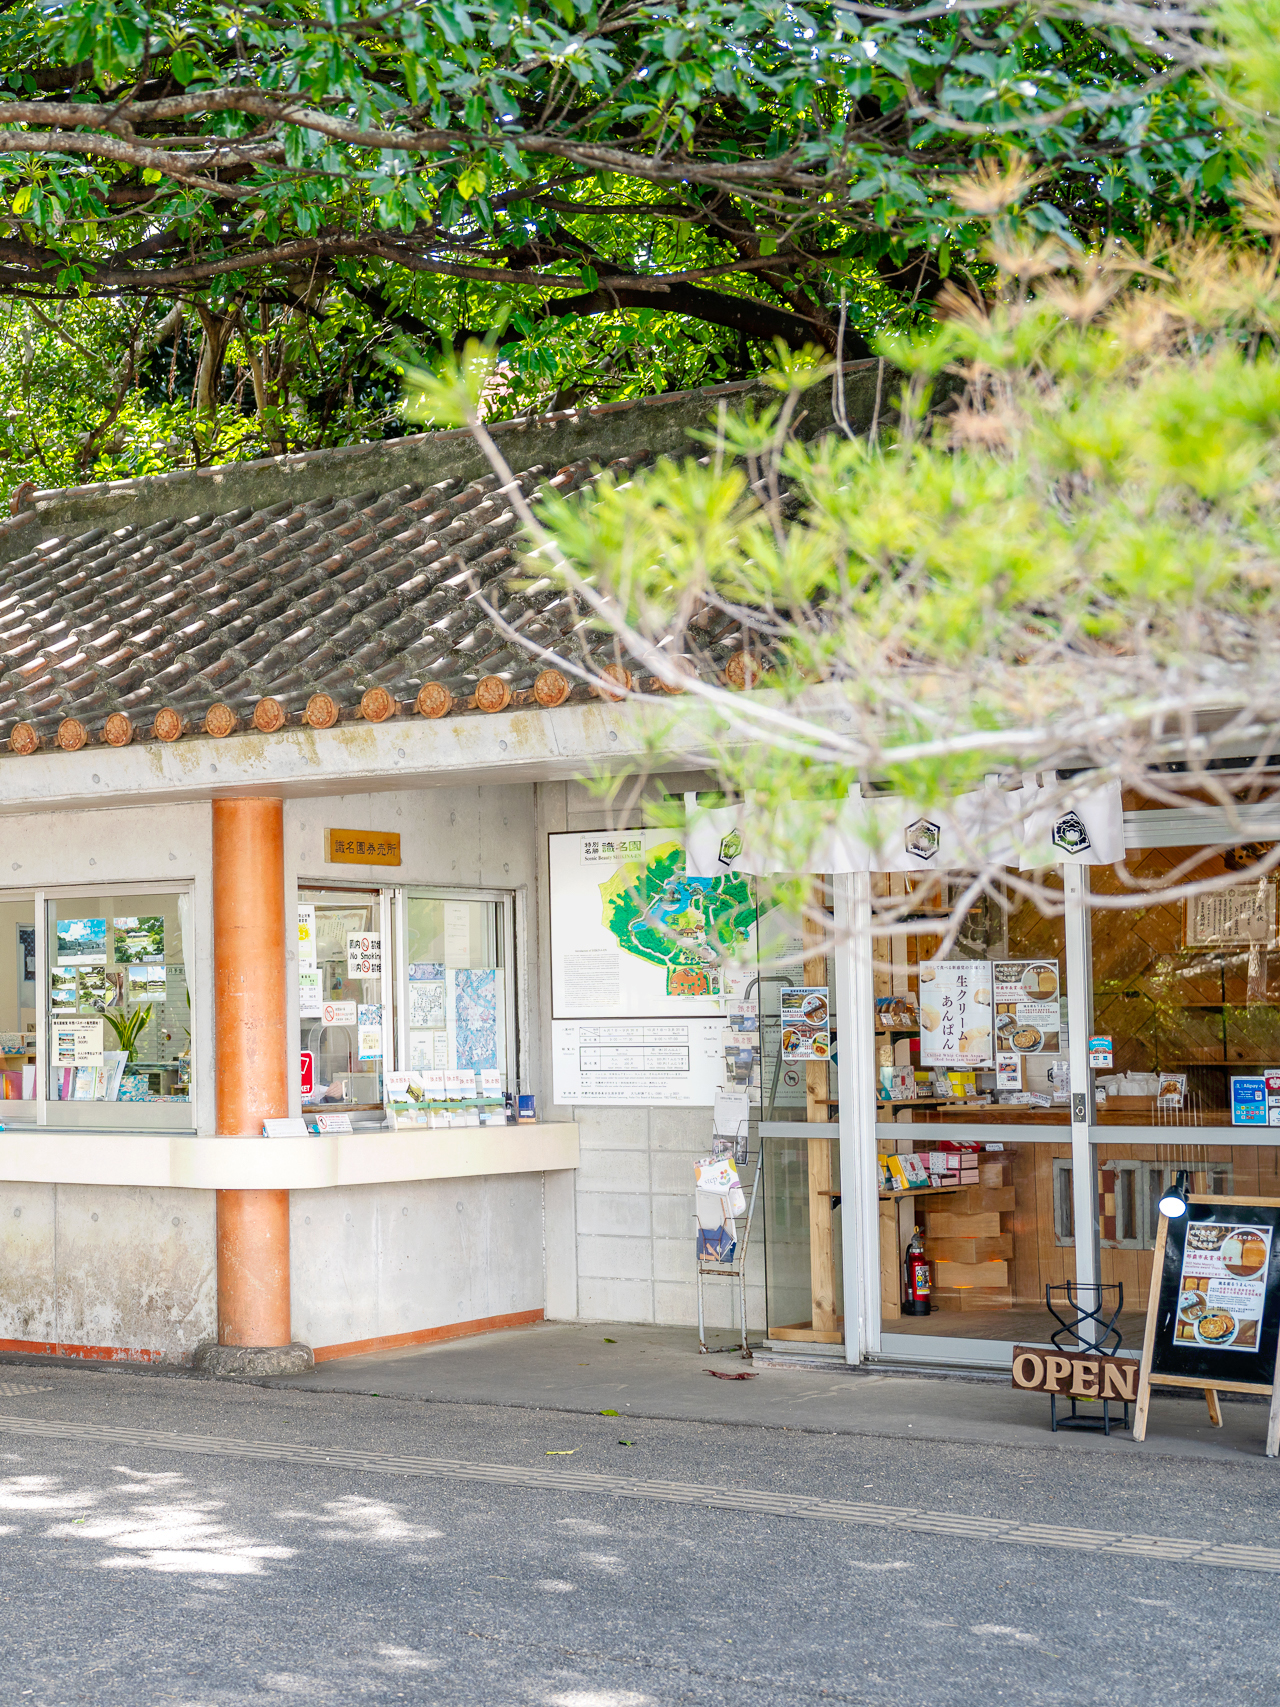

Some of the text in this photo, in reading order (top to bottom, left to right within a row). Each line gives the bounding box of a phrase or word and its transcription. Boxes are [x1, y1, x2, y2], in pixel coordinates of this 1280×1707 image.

[335, 840, 396, 856] 識名園券売所
[942, 995, 954, 1050] あんぱん
[956, 975, 968, 1041] 生クリーム
[1013, 1354, 1138, 1399] OPEN
